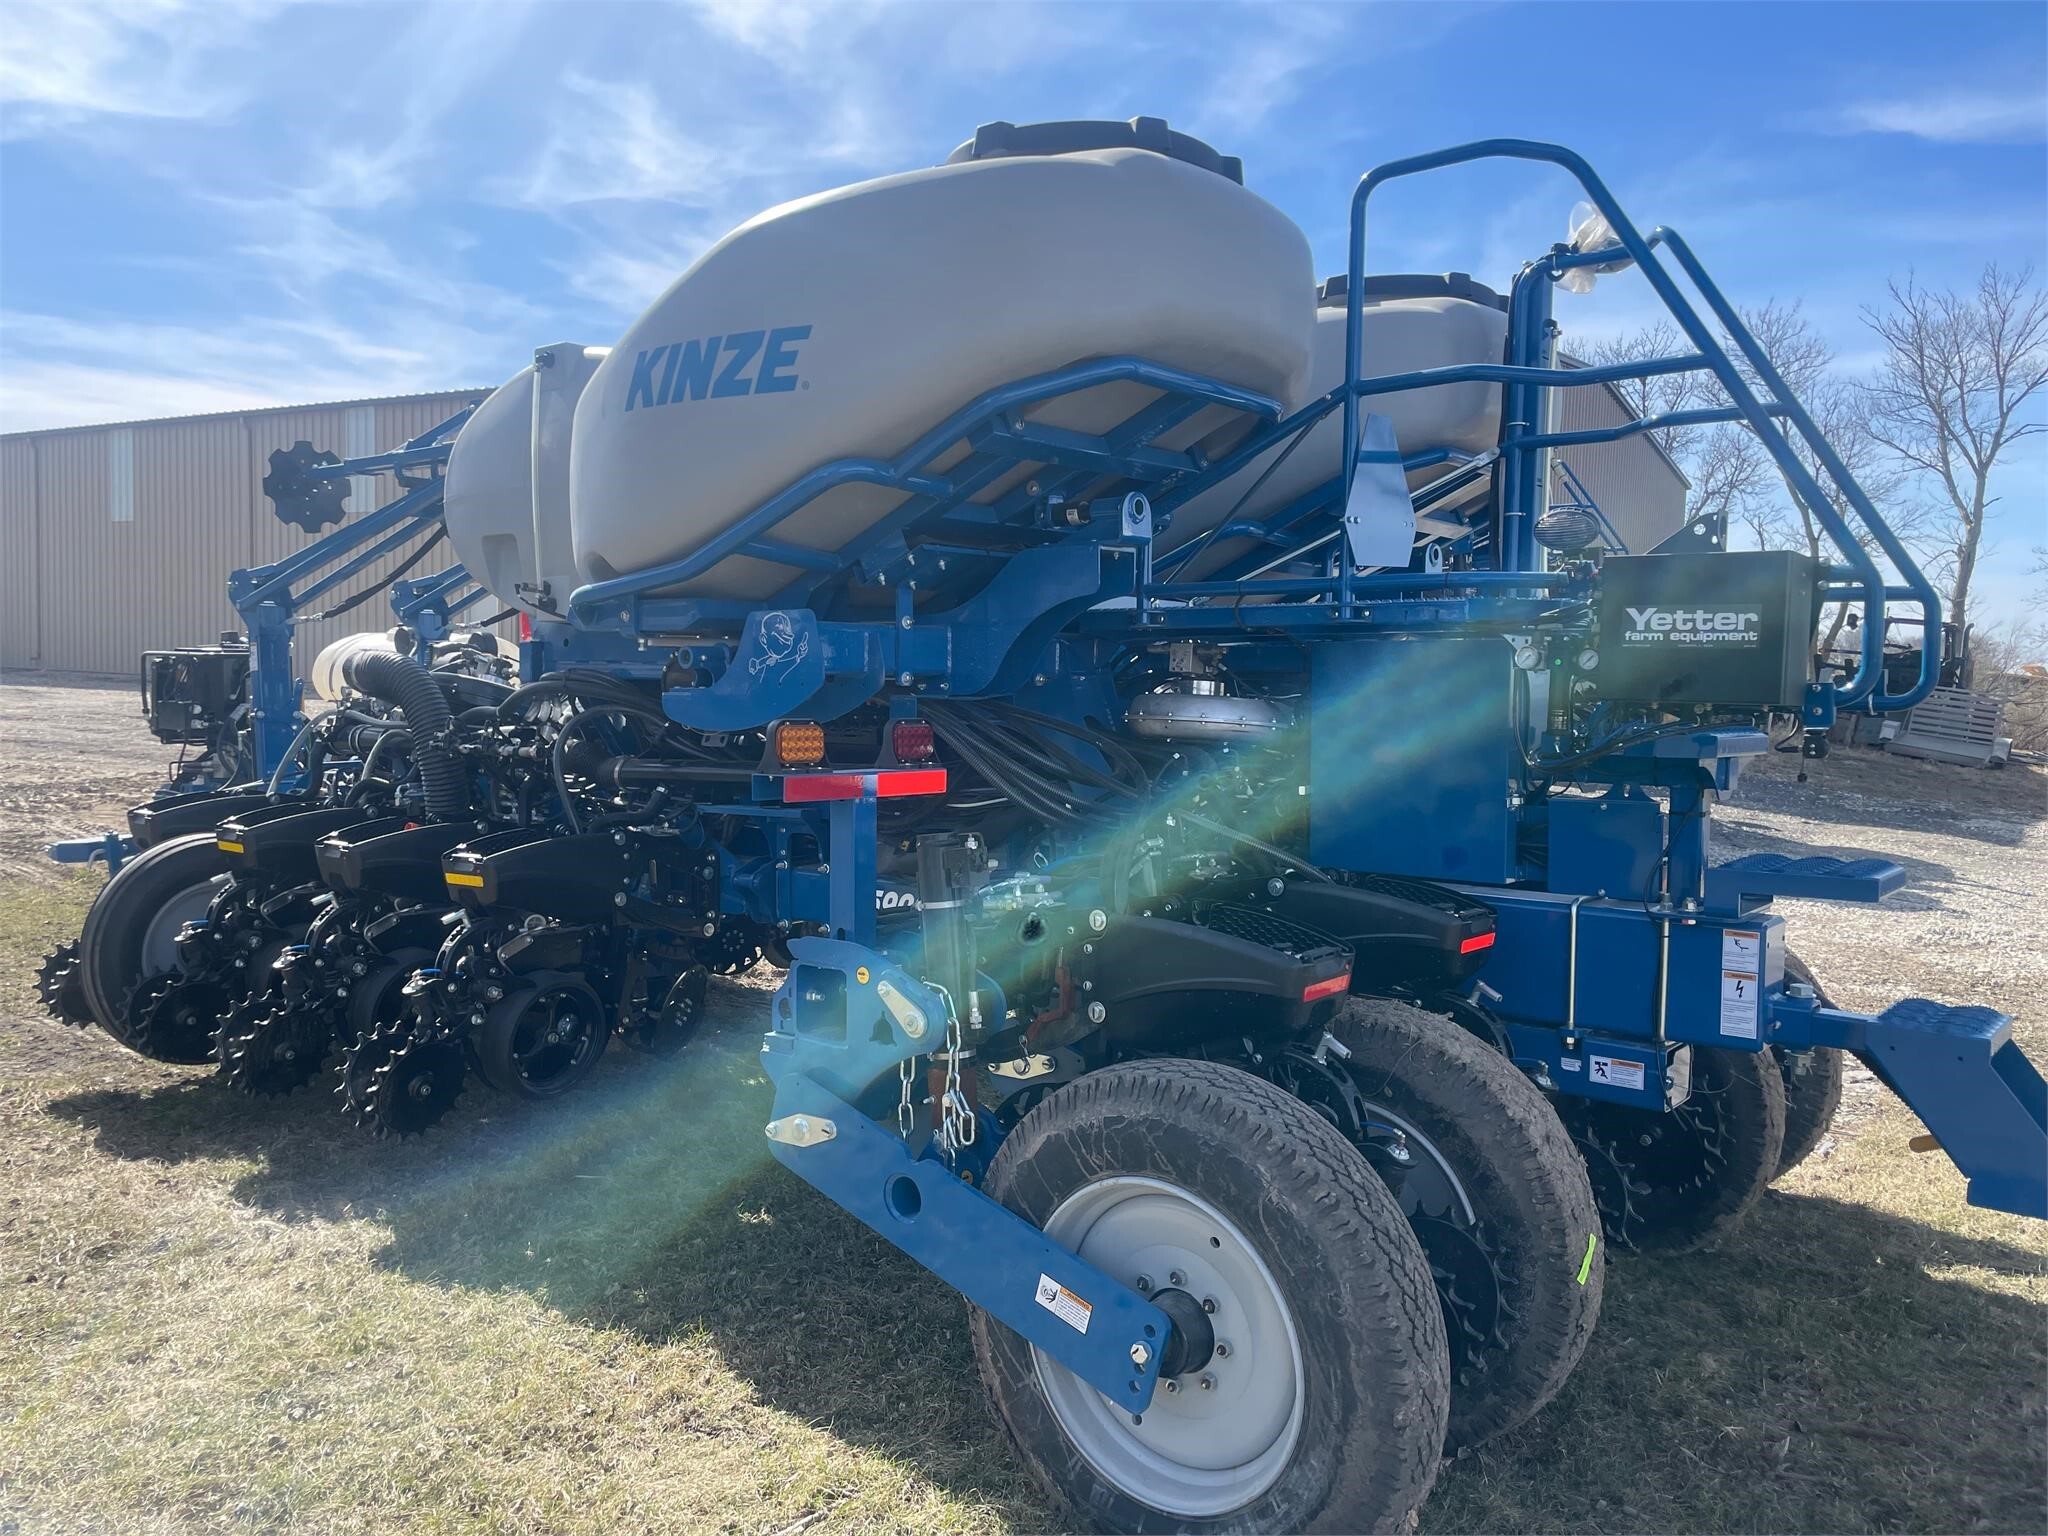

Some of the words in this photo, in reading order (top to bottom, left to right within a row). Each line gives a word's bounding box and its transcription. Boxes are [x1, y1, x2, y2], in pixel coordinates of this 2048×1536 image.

[625, 325, 812, 412] KINZE
[1625, 607, 1759, 631] Yetter
[1625, 630, 1664, 641] farm
[1670, 631, 1758, 643] equipment
